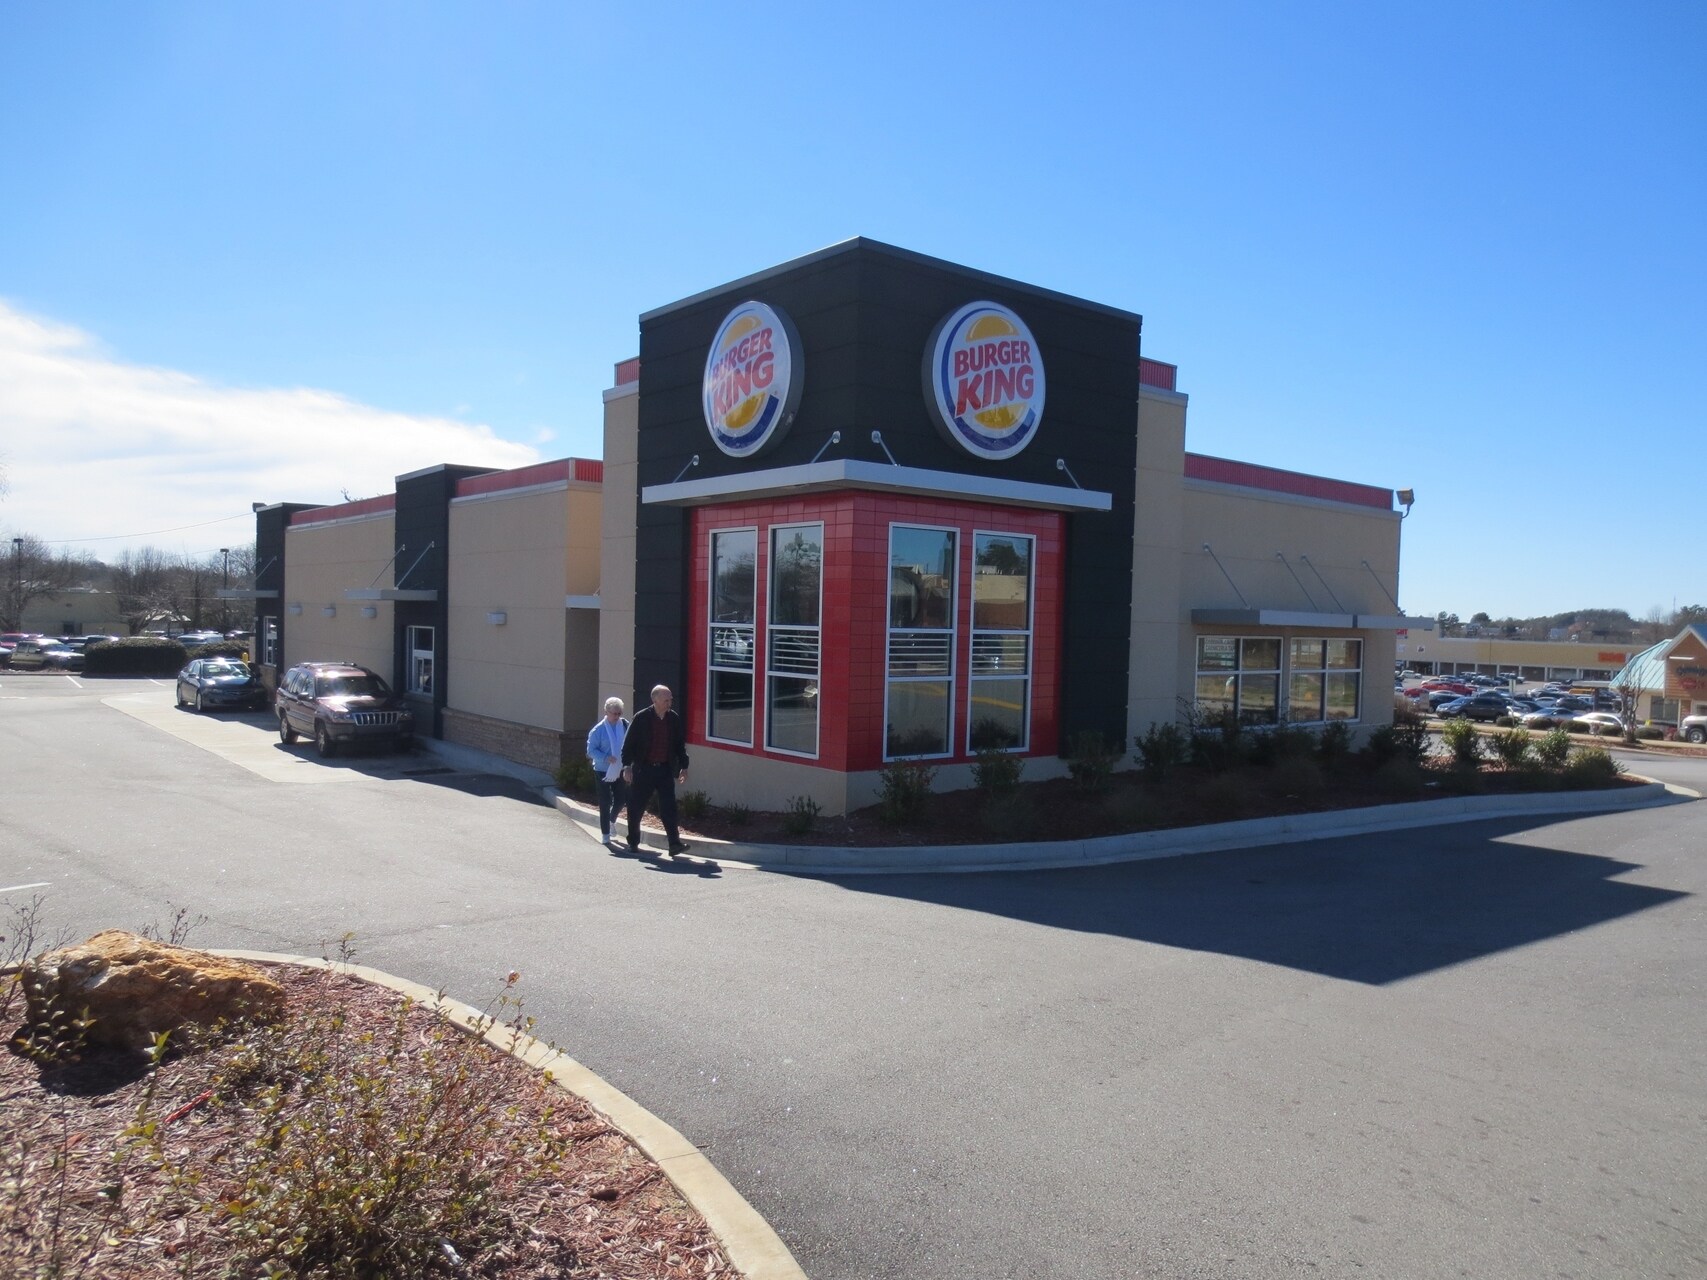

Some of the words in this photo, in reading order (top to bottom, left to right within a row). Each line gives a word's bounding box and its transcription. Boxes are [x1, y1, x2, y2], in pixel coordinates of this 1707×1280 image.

[712, 328, 773, 380] BURGER
[954, 340, 1032, 378] BURGER
[711, 351, 775, 426] KING
[955, 364, 1035, 417] KING
